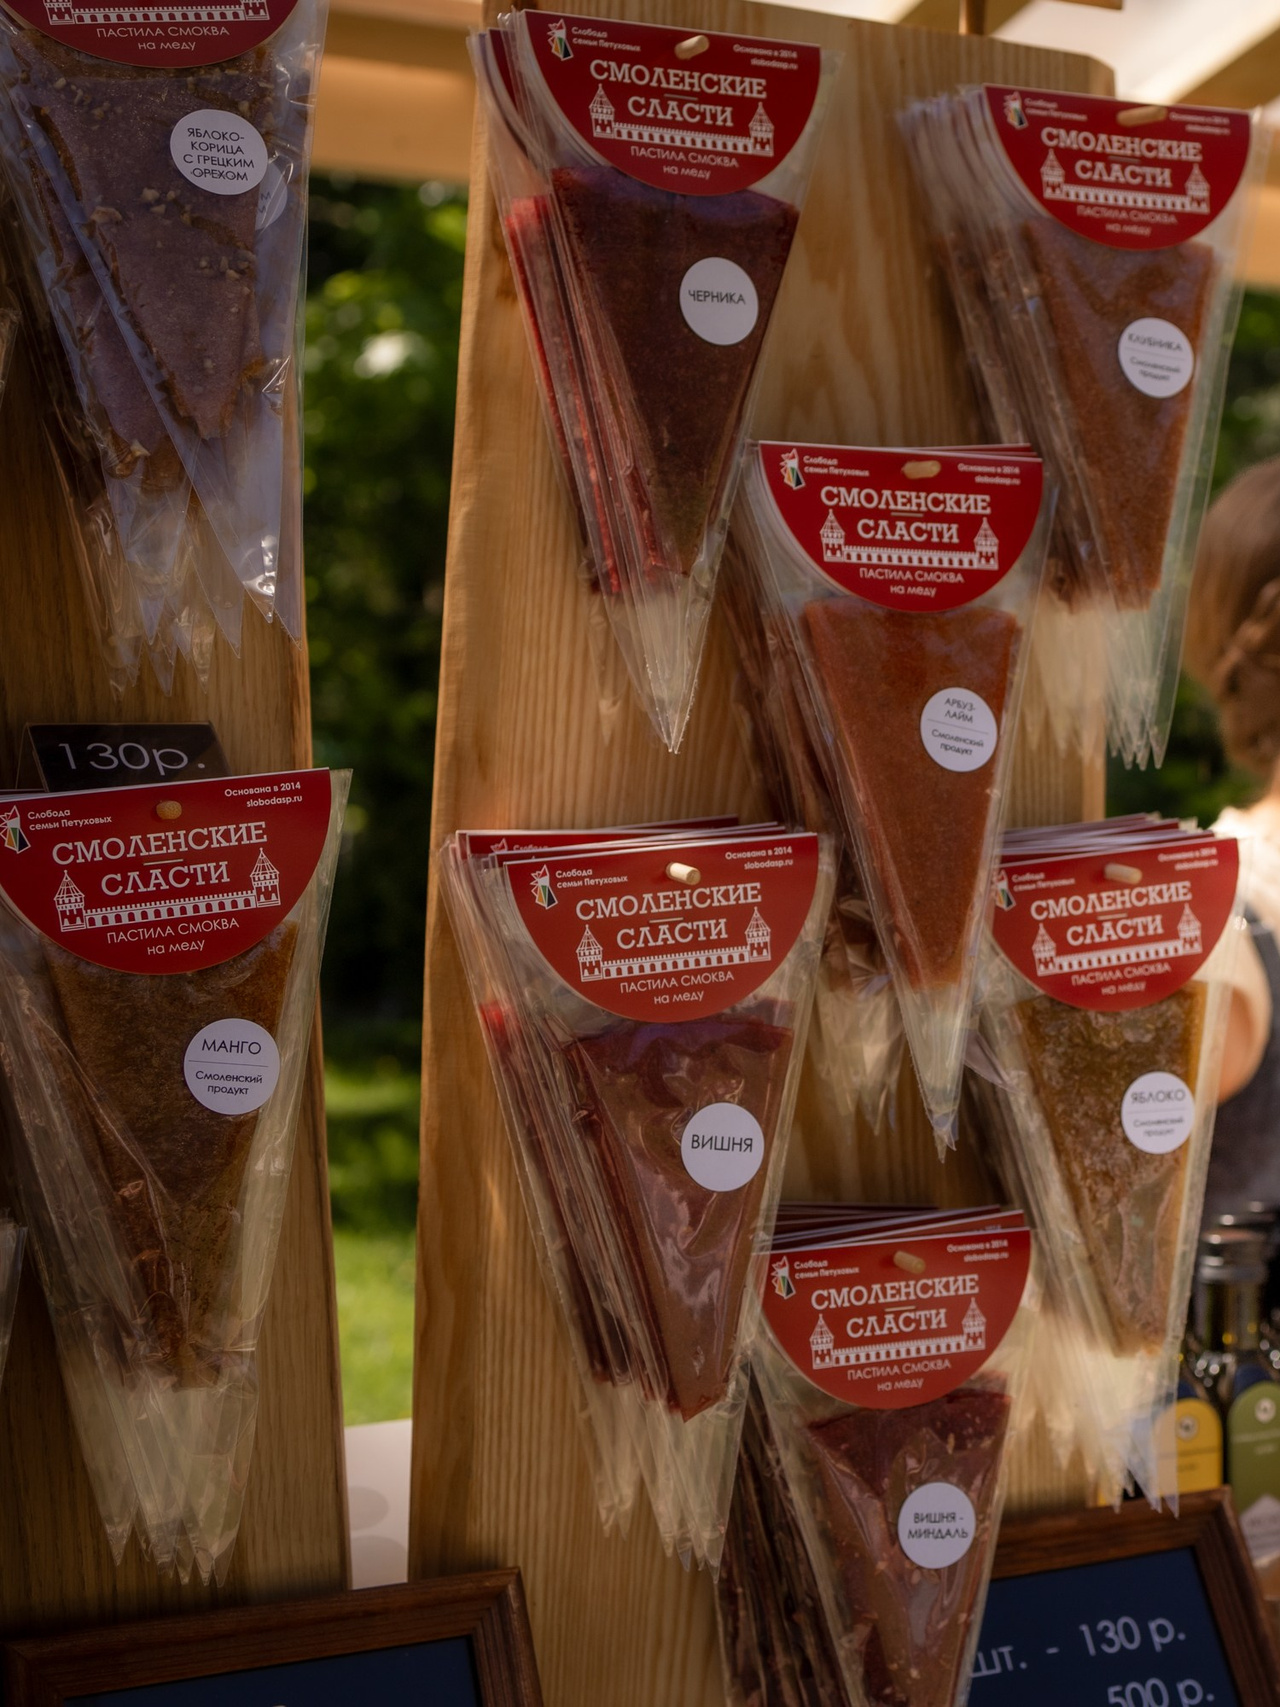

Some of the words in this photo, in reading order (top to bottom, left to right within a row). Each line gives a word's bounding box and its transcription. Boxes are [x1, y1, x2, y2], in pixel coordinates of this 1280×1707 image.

[97, 27, 165, 38] ПАСТИЛА
[168, 26, 230, 37] СМОКВА
[572, 26, 608, 39] Слобода
[138, 41, 157, 50] на
[161, 40, 196, 51] меду
[572, 37, 597, 47] семьи
[599, 39, 642, 52] Петуховых
[733, 44, 773, 57] Основана
[780, 49, 798, 59] 2014
[589, 59, 767, 99] СМОЛЕНСКИЕ
[628, 96, 734, 127] СЛАСТИ
[187, 127, 245, 142] ЯБЛОКО-
[191, 141, 245, 155] КОРИЦА
[1041, 126, 1203, 163] СМОЛЕНСКИЕ
[183, 153, 193, 164] С
[197, 154, 255, 169] ГРЕЦКИМ
[631, 145, 686, 163] ПАСТИЛА
[688, 150, 740, 169] СМОКВА
[192, 167, 249, 181] ОРЕХОМ
[663, 164, 679, 176] на
[681, 166, 712, 181] меду
[1075, 159, 1173, 188] СЛАСТИ
[1077, 204, 1129, 221] ПАСТИЛА
[1130, 208, 1179, 225] СМОКВА
[1106, 222, 1121, 233] на
[1123, 225, 1152, 237] меду
[688, 289, 746, 306] ЧЕРНИКА
[803, 454, 838, 466] Слобода
[804, 465, 829, 475] семьи
[829, 466, 870, 478] Петуховых
[957, 462, 996, 474] Основана
[1002, 466, 1020, 475] 2014
[820, 486, 992, 515] СМОЛЕНСКИЕ
[857, 518, 960, 544] СЛАСТИ
[859, 567, 914, 582] ПАСТИЛА
[915, 570, 965, 584] СМОКВА
[890, 584, 905, 595] на
[907, 585, 937, 598] меду
[944, 697, 976, 712] АРБУЗ-
[944, 709, 974, 724] ЛАЙМ
[931, 728, 985, 748] Смоленский
[939, 742, 973, 756] продукт
[58, 742, 206, 776] 130р.
[224, 786, 272, 798] Основана
[280, 781, 302, 791] 2014
[246, 793, 303, 808] slobodasp.ru
[27, 808, 71, 820] Слобода
[29, 819, 60, 831] семьи
[61, 814, 113, 829] Петуховых
[51, 820, 269, 867] СМОЛЕНСКИЕ
[725, 848, 767, 860] Основана
[773, 845, 793, 856] 2014
[744, 859, 793, 871] slobodasp.ru
[100, 861, 232, 898] СЛАСТИ
[555, 868, 593, 879] Слобода
[556, 879, 584, 889] семьи
[584, 875, 629, 887] Петуховых
[575, 882, 762, 922] СМОЛЕНСКИЕ
[1030, 880, 1193, 920] СМОЛЕНСКИЕ
[106, 925, 175, 945] ПАСТИЛА
[177, 917, 240, 936] СМОКВА
[616, 918, 728, 951] СЛАСТИ
[1066, 914, 1165, 947] СЛАСТИ
[146, 942, 166, 956] на
[168, 939, 206, 954] меду
[1071, 969, 1124, 987] ПАСТИЛА
[1125, 961, 1172, 977] СМОКВА
[620, 977, 679, 995] ПАСТИЛА
[680, 970, 735, 987] СМОКВА
[1101, 985, 1117, 996] на
[1118, 981, 1147, 995] меду
[653, 993, 671, 1006] на
[672, 990, 706, 1004] меду
[201, 1038, 262, 1056] МАНГО
[195, 1070, 263, 1085] Смоленский
[207, 1083, 250, 1097] продукт
[1130, 1088, 1187, 1105] ЯБЛОКО
[691, 1133, 754, 1154] ВИШНЯ
[946, 1241, 984, 1253] Основана
[991, 1239, 1009, 1249] 2014
[794, 1259, 829, 1270] Слобода
[795, 1269, 819, 1280] семьи
[819, 1265, 860, 1278] Петуховых
[811, 1273, 980, 1311] СМОЛЕНСКИЕ
[846, 1307, 948, 1339] СЛАСТИ
[847, 1364, 901, 1382] ПАСТИЛА
[902, 1358, 953, 1375] СМОКВА
[877, 1380, 894, 1393] на
[895, 1377, 924, 1391] меду
[913, 1511, 957, 1525] ВИШНЯ
[907, 1526, 969, 1541] МИНДАЛЬ
[1079, 1615, 1142, 1657] 130
[1147, 1617, 1187, 1653] р.
[1107, 1677, 1170, 1707] 500
